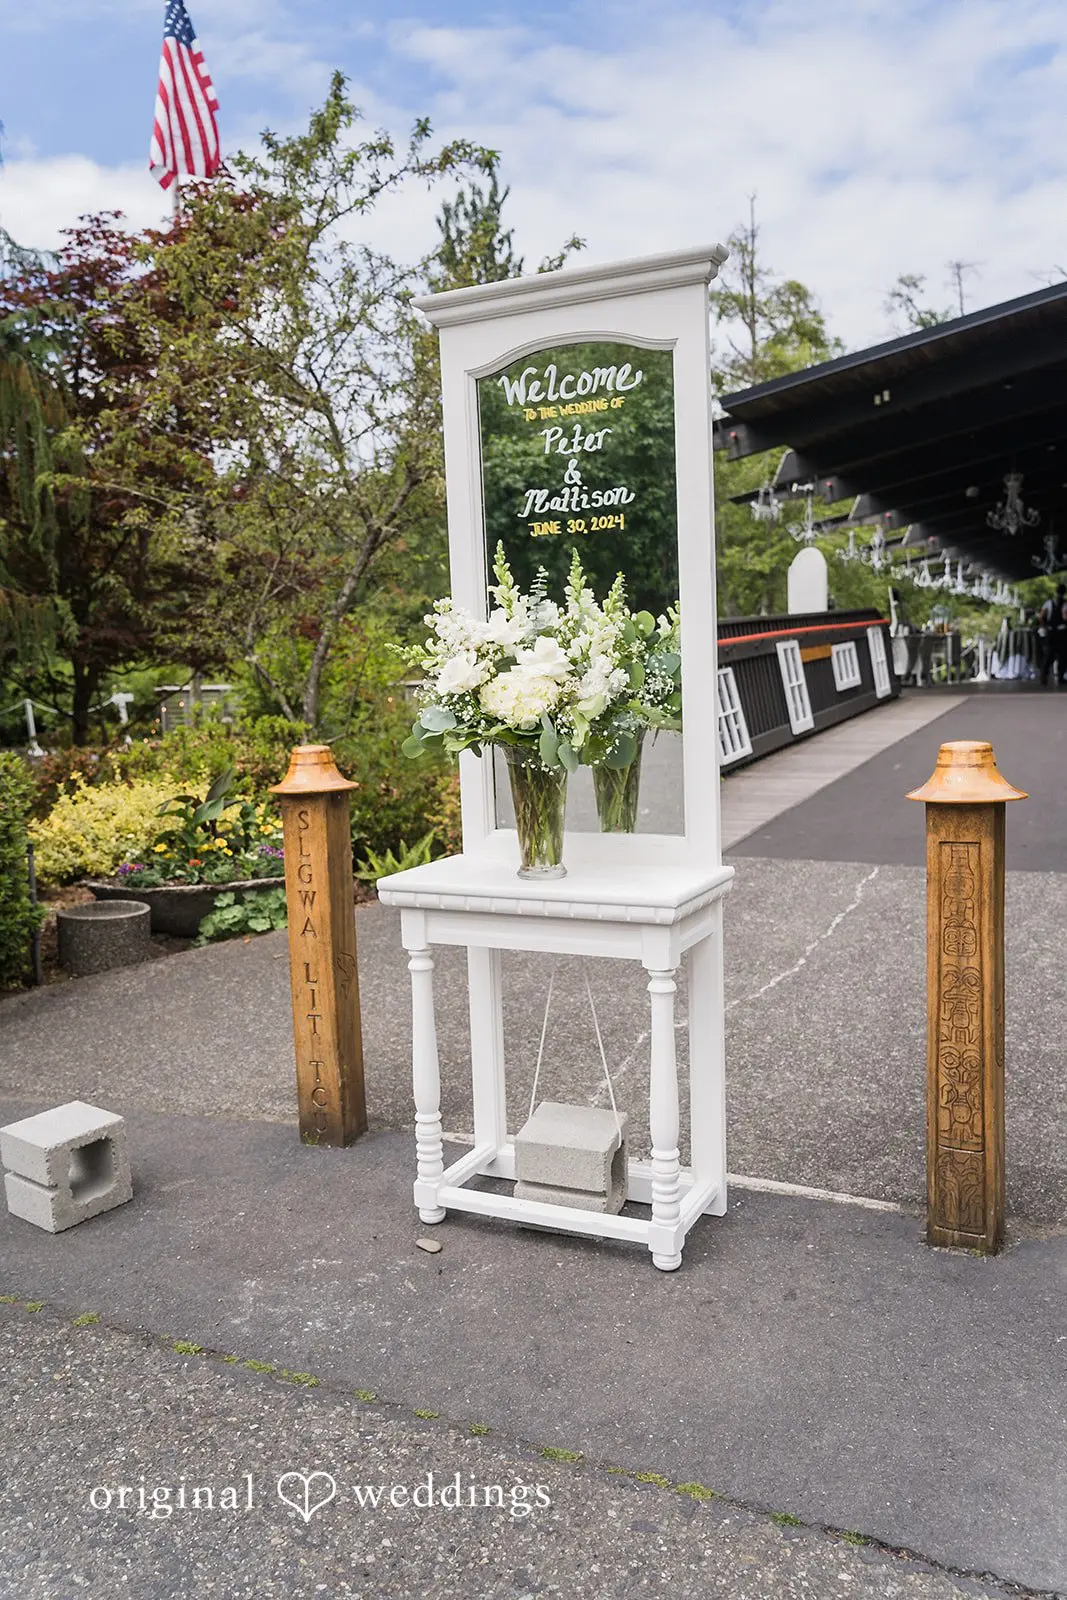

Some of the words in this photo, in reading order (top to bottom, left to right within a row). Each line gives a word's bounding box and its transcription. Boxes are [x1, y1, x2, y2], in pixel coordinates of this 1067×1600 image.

[498, 364, 643, 406] Welcome
[537, 405, 559, 420] THE
[559, 398, 610, 416] WEDDING
[610, 396, 626, 409] OF
[540, 423, 612, 454] Peter
[564, 458, 583, 485] &
[517, 486, 635, 518] Mattison
[528, 520, 562, 537] JUNE
[566, 518, 589, 534] 30,
[590, 513, 625, 534] 2024
